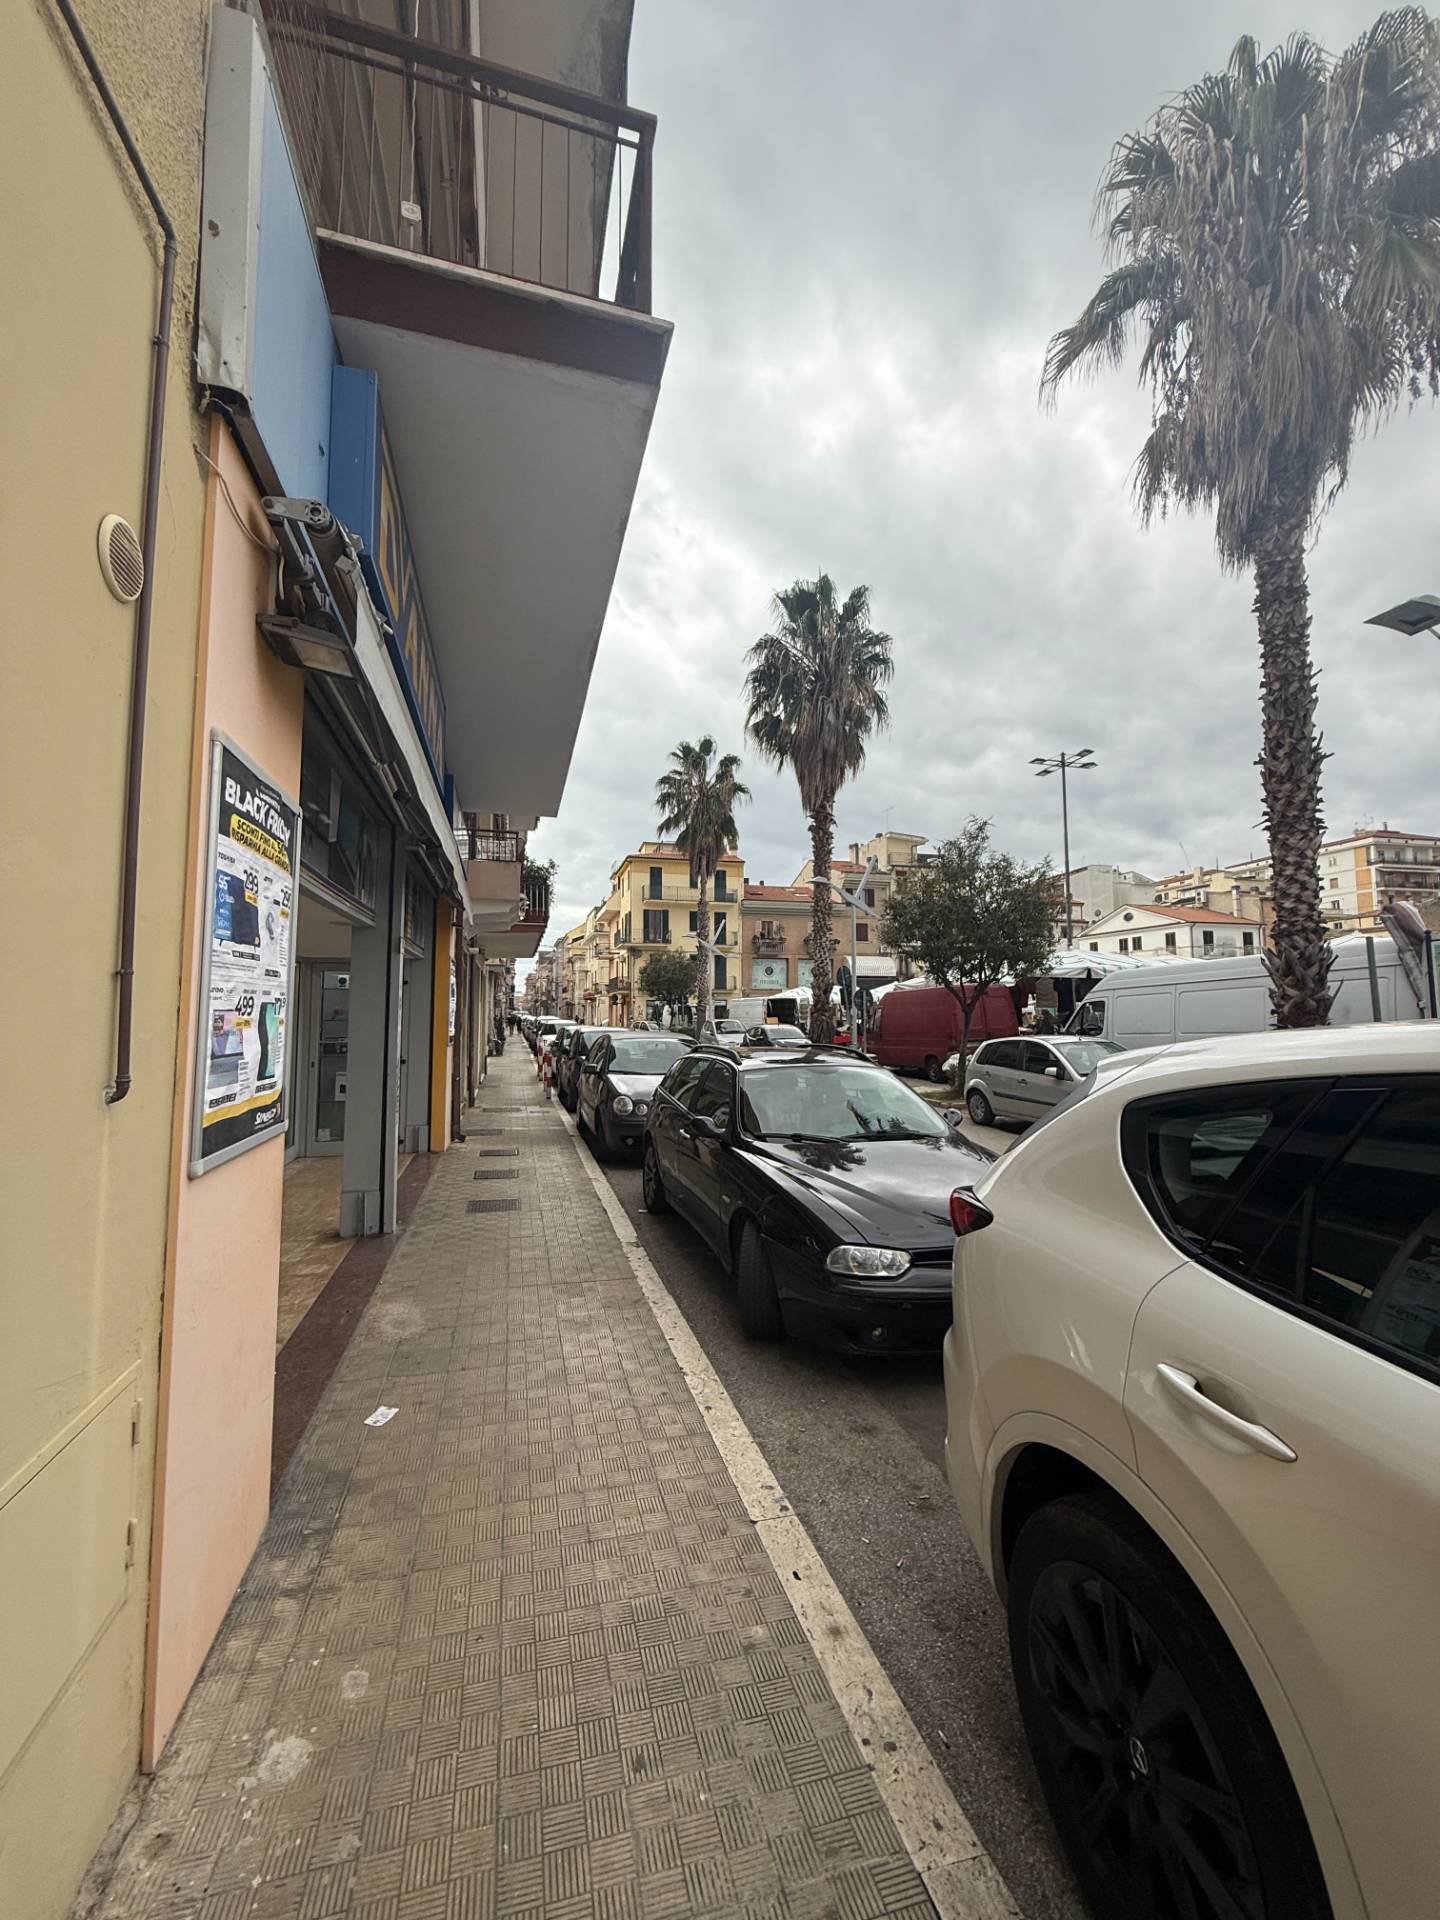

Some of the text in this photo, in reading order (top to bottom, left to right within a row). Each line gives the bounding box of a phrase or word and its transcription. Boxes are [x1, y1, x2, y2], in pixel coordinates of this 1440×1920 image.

[225, 777, 268, 827] BLACK
[243, 869, 258, 894] 299
[234, 995, 254, 1016] 499
